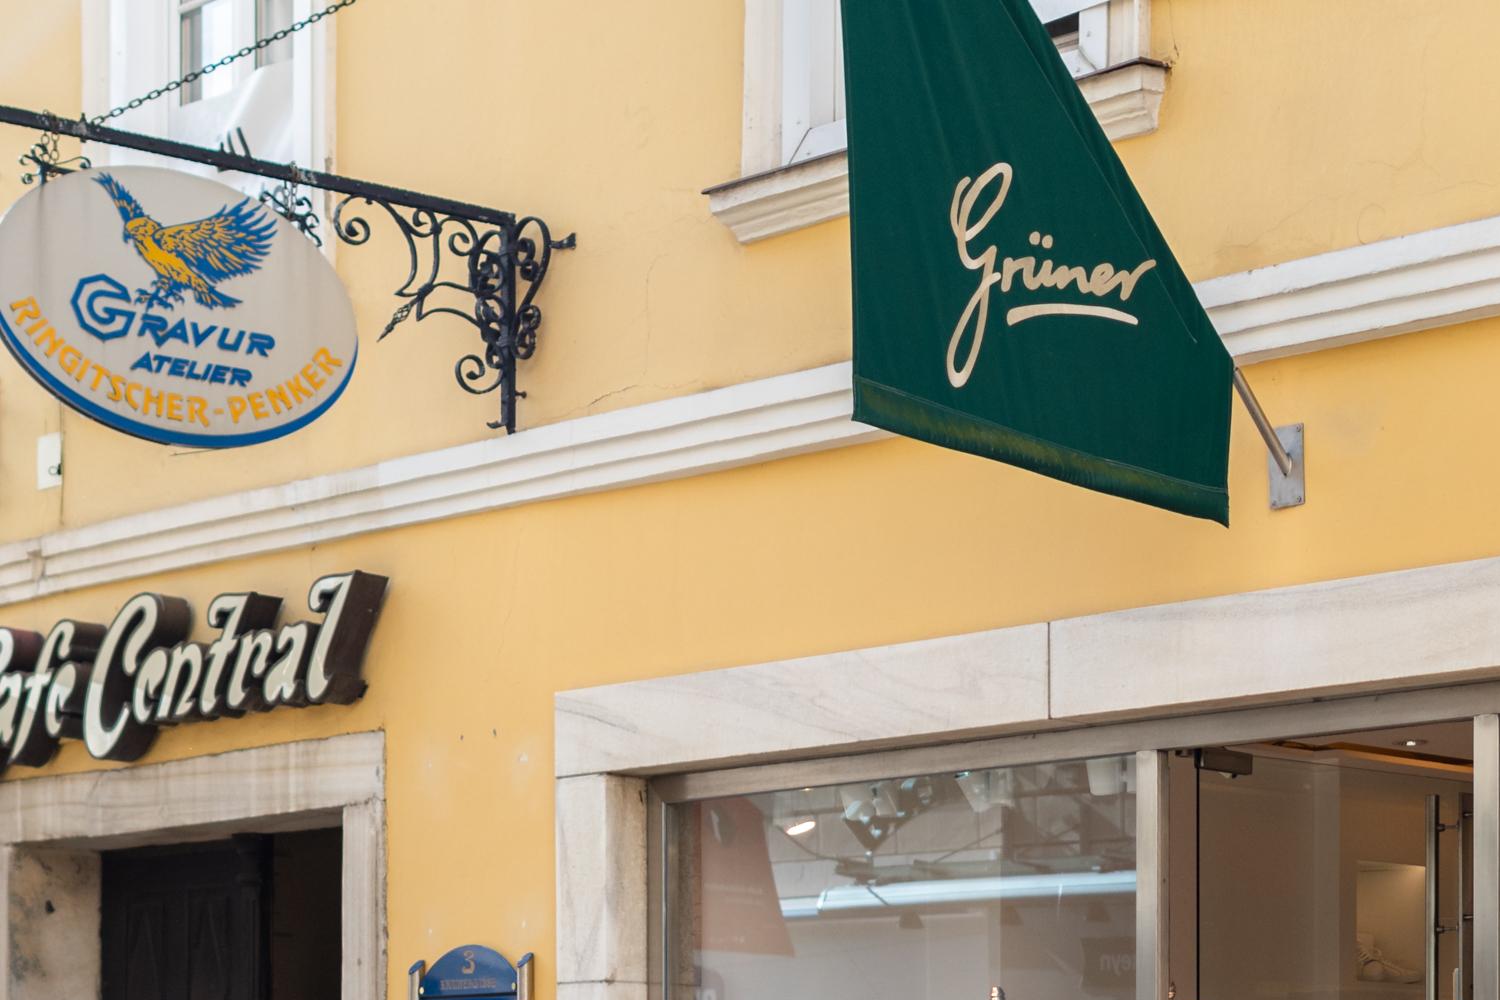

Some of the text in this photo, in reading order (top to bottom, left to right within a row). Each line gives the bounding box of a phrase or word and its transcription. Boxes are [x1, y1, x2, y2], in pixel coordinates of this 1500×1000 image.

[70, 272, 276, 359] GRAVUR
[946, 161, 1157, 389] Grüner
[130, 350, 254, 388] ATELIER
[83, 569, 356, 760] Central
[462, 951, 475, 975] 3
